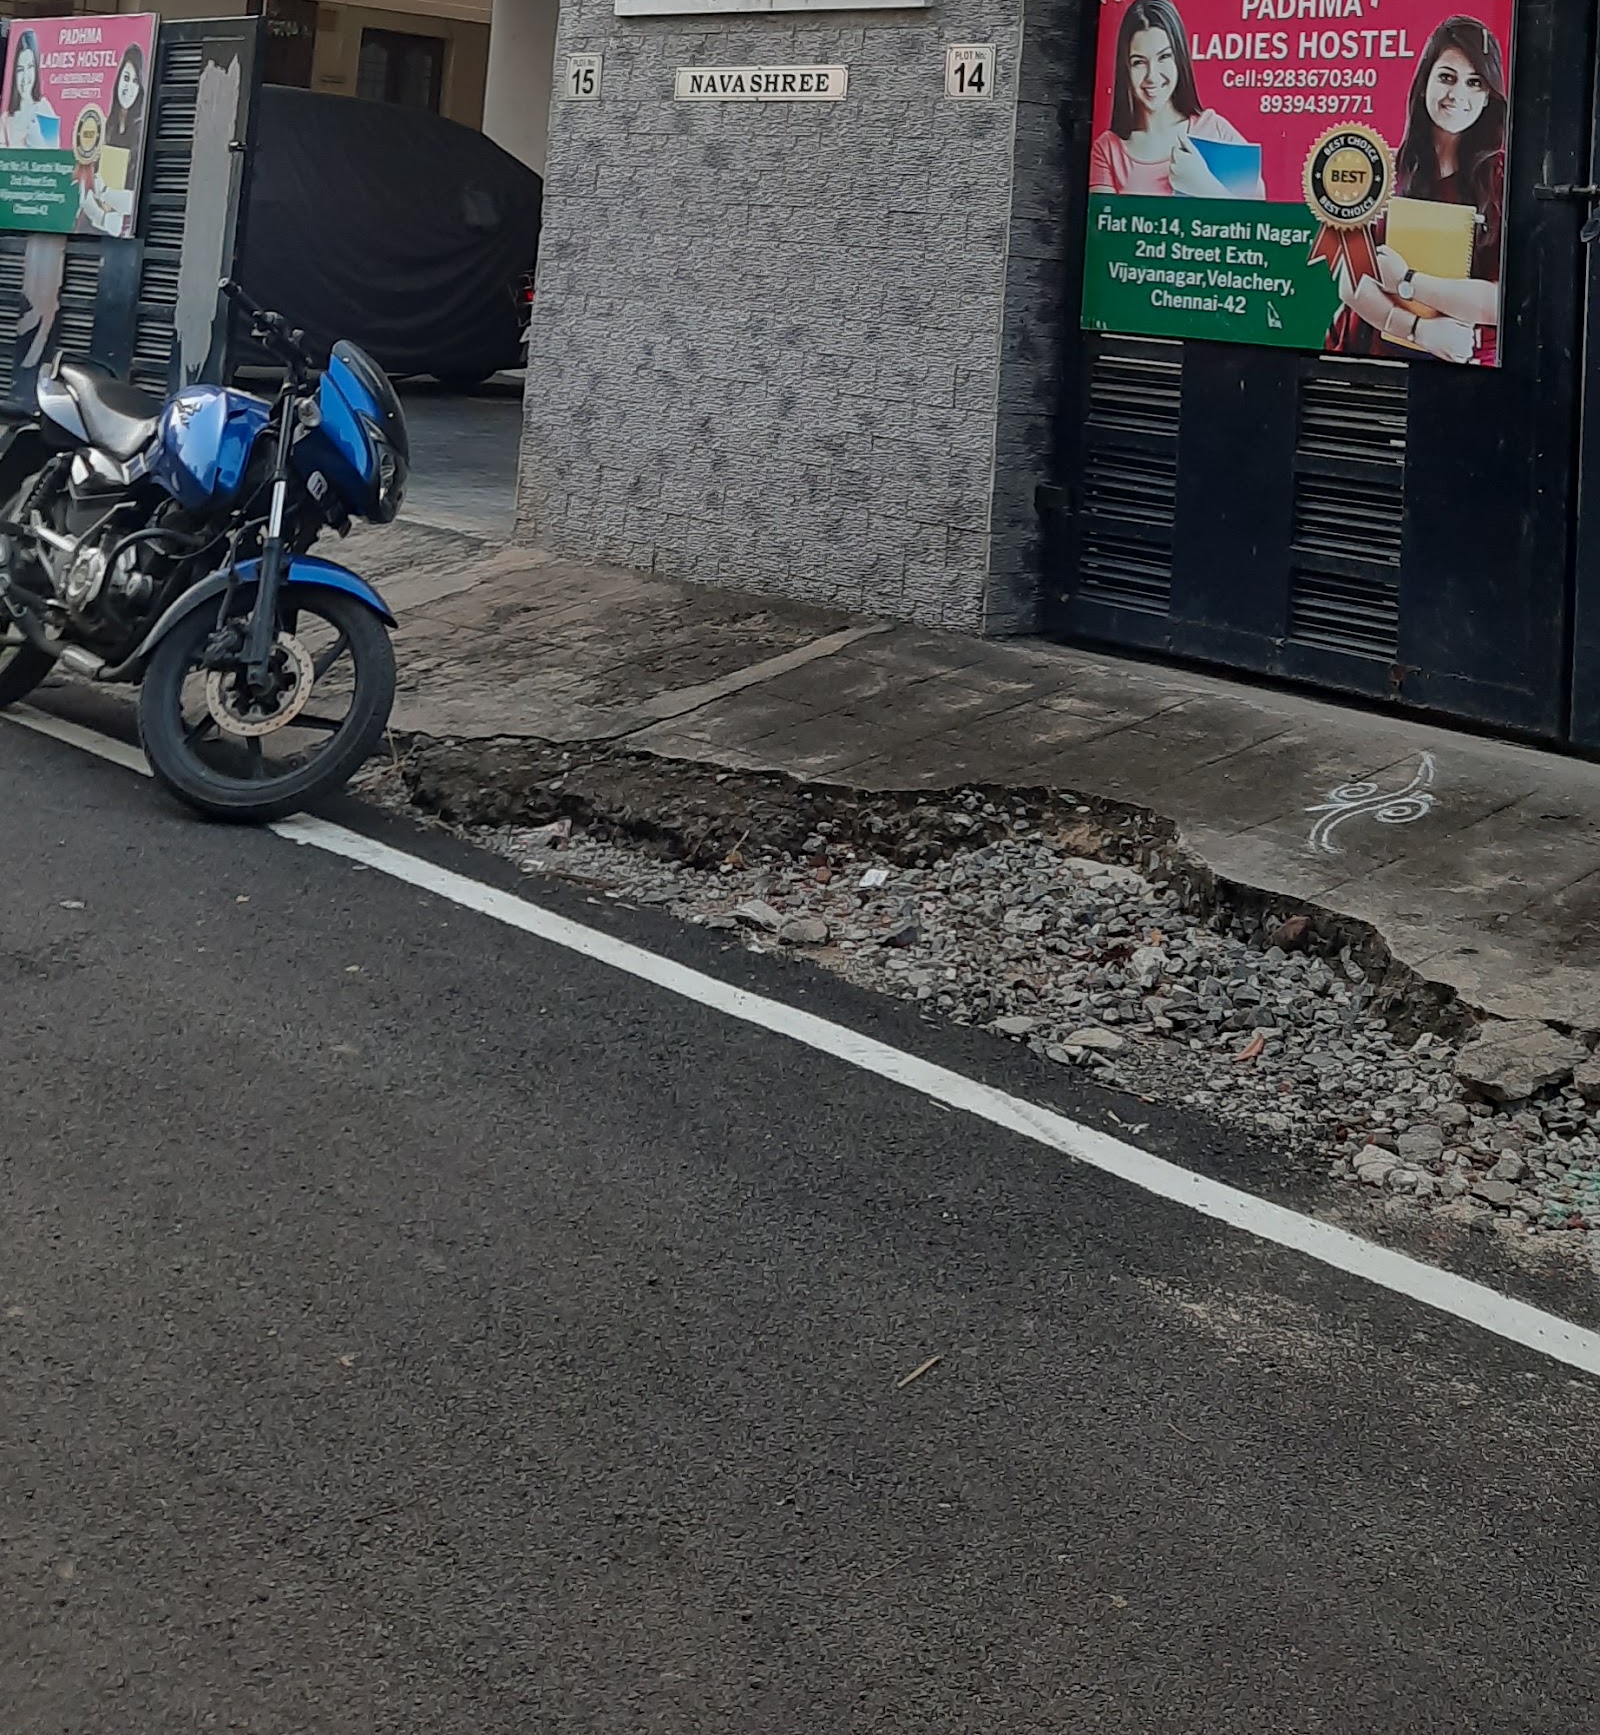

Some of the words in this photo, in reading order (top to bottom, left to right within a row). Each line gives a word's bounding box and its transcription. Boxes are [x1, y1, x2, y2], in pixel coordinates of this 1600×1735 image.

[58, 27, 102, 45] PADHMA
[1191, 31, 1288, 60] LADIES
[1299, 29, 1415, 59] HOSTEL
[572, 68, 594, 95] 15
[954, 62, 985, 93] 14
[1222, 68, 1377, 88] Cell:9283670340
[1259, 94, 1374, 114] 8939439771
[1323, 136, 1346, 156] BEST
[1347, 135, 1380, 163] CHOICE
[1331, 169, 1367, 184] BEST
[1319, 195, 1340, 215] BEST
[1097, 214, 1127, 232] Flat
[1131, 216, 1185, 238] No:14,
[1191, 219, 1251, 241] Sarathi
[1256, 223, 1314, 246] Nagar,
[1135, 240, 1166, 258] 2nd
[1171, 242, 1221, 263] Street
[1226, 246, 1269, 268] Extn,
[1151, 289, 1246, 314] Chennai-42
